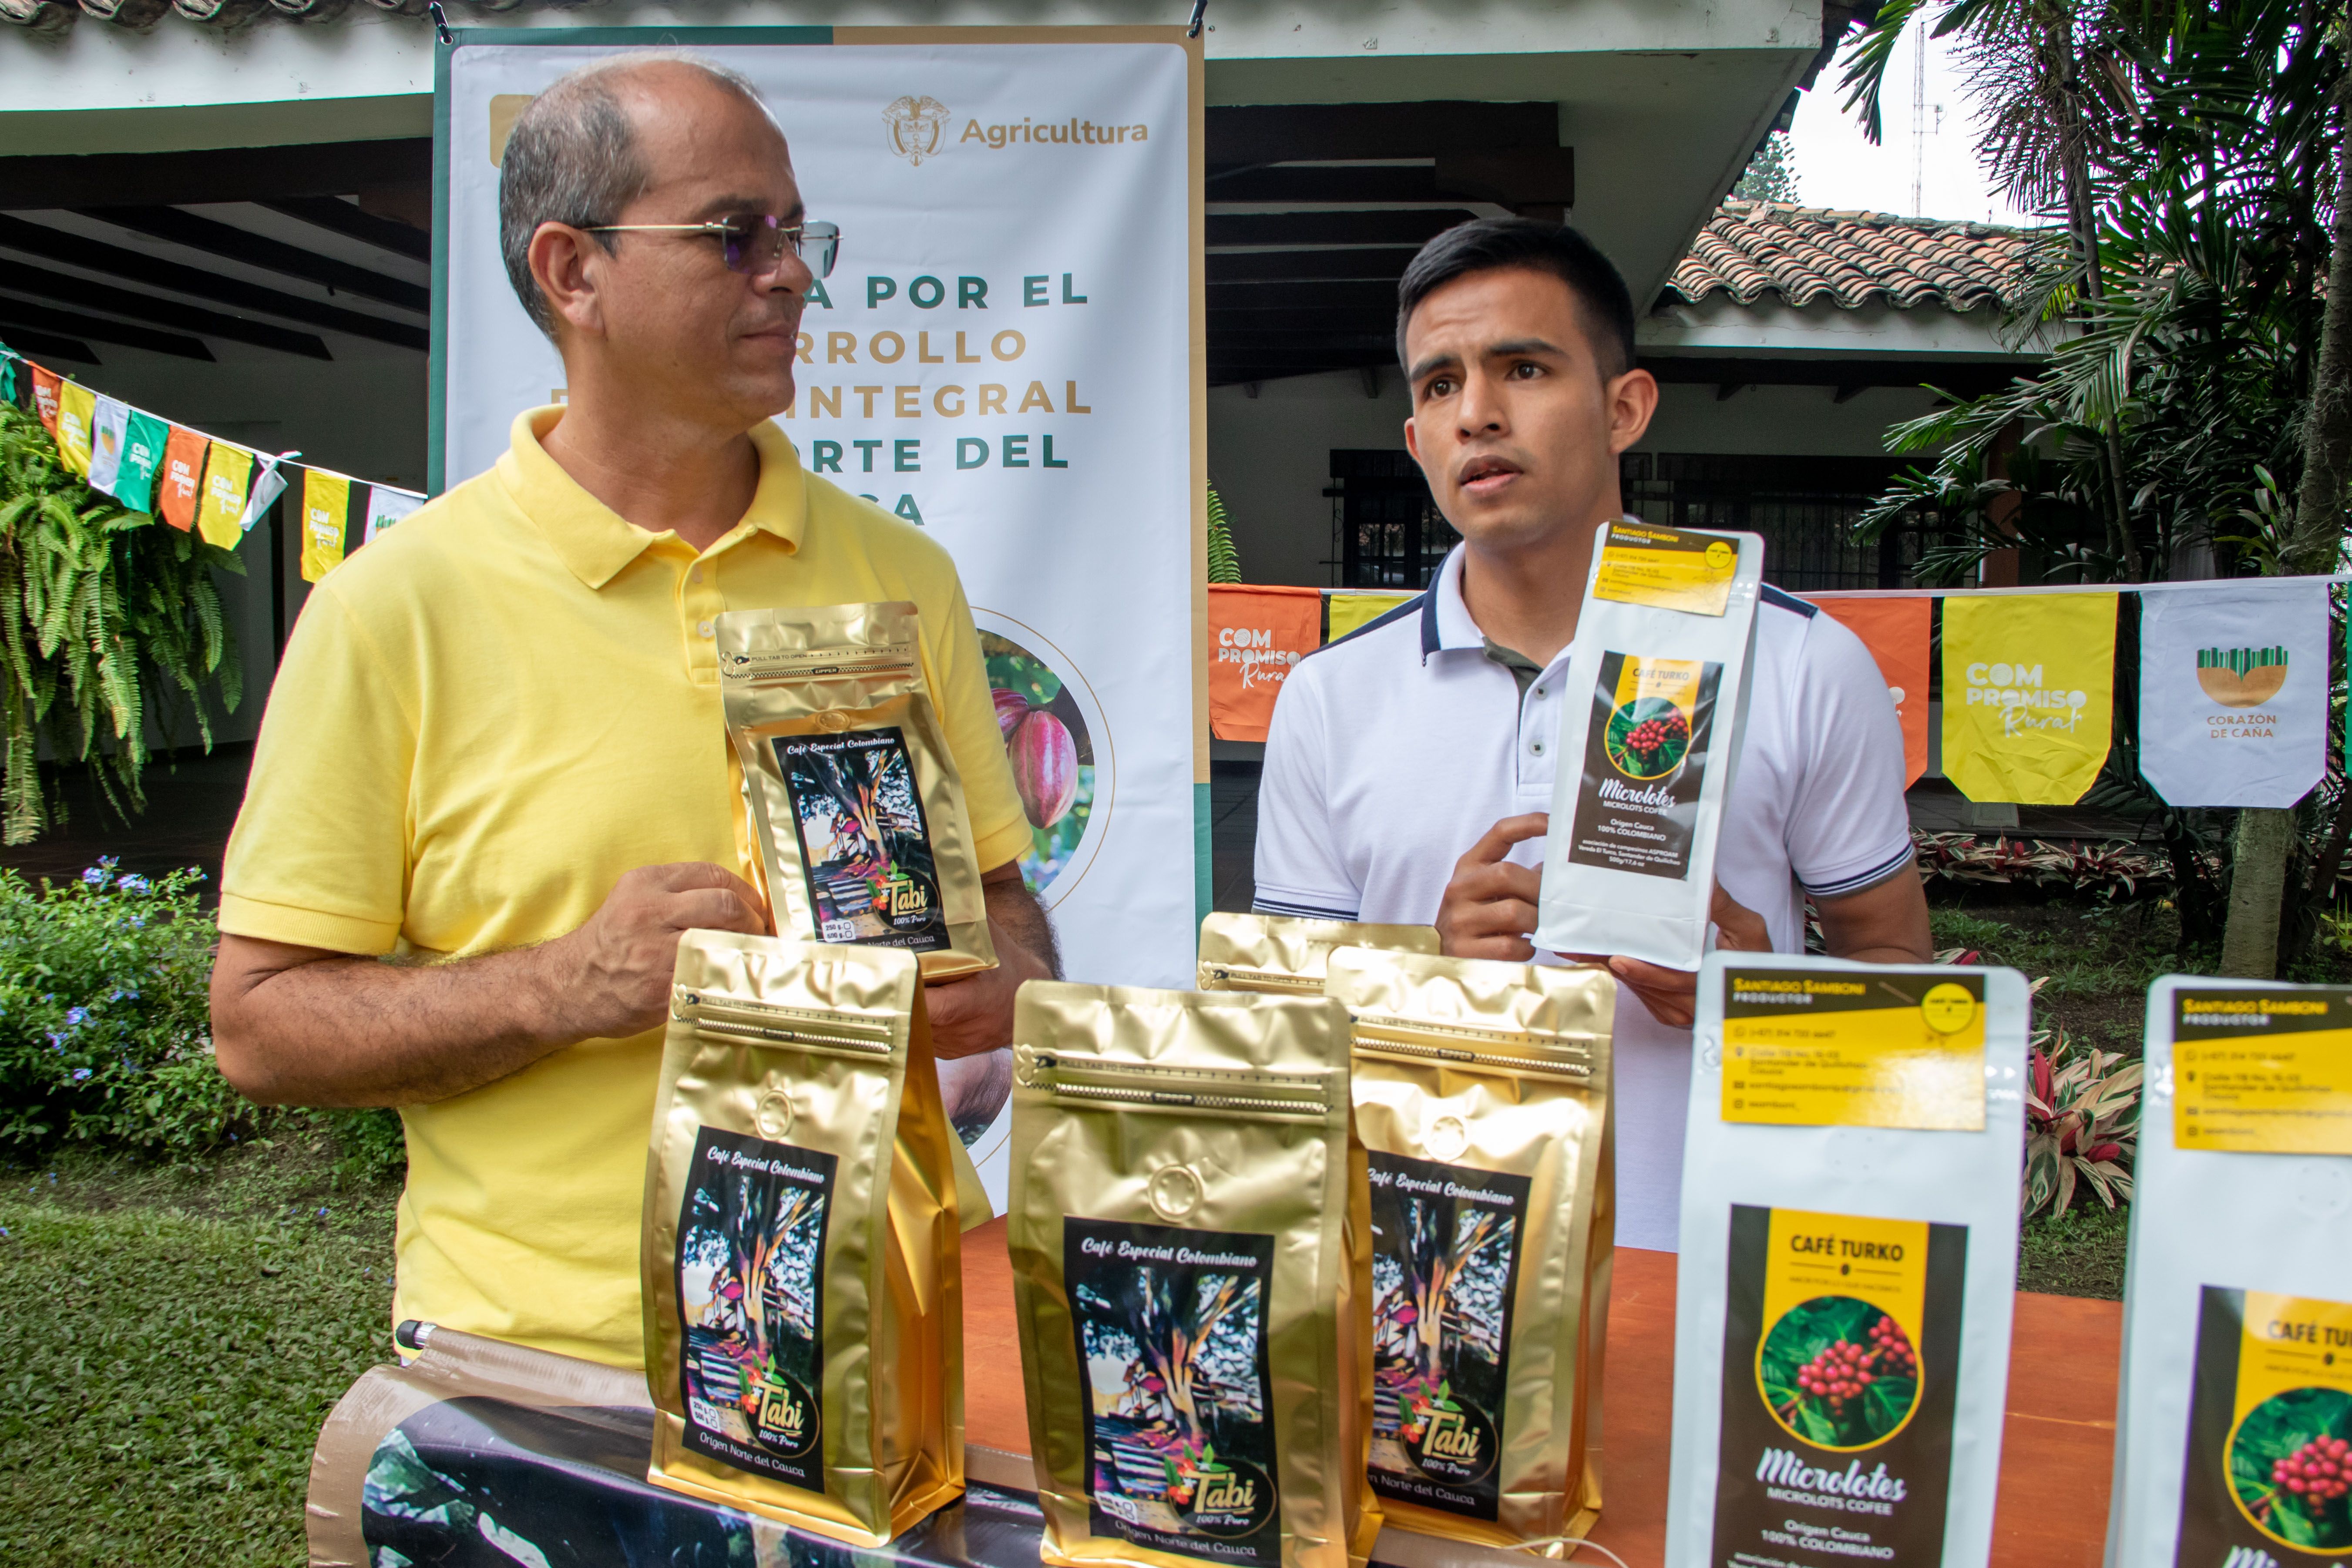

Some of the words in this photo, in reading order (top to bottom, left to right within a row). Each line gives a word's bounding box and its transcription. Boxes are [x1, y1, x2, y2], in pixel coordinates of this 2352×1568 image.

[960, 117, 1148, 149] Agricultura
[867, 275, 988, 309] POR
[1023, 272, 1088, 308] EL
[796, 329, 1026, 364] RROLLO
[792, 439, 921, 473] RTE
[956, 434, 1068, 470] DEL
[171, 460, 190, 476] COM
[170, 471, 196, 489] PROMISO
[212, 475, 233, 492] COM
[211, 487, 242, 504] PROMISO
[310, 507, 330, 524] COM
[309, 520, 340, 537] PROMISO
[1611, 533, 1652, 544] PRODUCTOR
[1219, 628, 1271, 648] COM
[1218, 648, 1301, 666] PROMISO
[1633, 668, 1656, 679] CAFÉ
[1658, 671, 1690, 681] TURKO
[1966, 662, 2043, 688] COM
[1966, 688, 2087, 709] PROMISO
[1998, 703, 2083, 738] Rural
[2207, 713, 2277, 725] CORAZÓN
[2211, 729, 2227, 739] DE
[2231, 726, 2274, 738] CAÑA
[787, 744, 807, 756] Café
[810, 742, 846, 752] Especial
[847, 737, 895, 749] Colombiano
[1598, 777, 1677, 808] Microlotes
[1603, 800, 1643, 813] MICROLOTS
[1643, 806, 1668, 816] COFEE
[1597, 825, 1616, 834] 100%
[1617, 828, 1667, 842] COLOMBIANO
[1610, 818, 1633, 828] Origen
[1634, 822, 1655, 831] Cauca
[881, 879, 929, 917] Tabi
[893, 916, 910, 926] 100%
[911, 915, 927, 923] Puro
[892, 937, 905, 947] del
[907, 935, 935, 945] Cauca
[1733, 991, 1813, 1005] PRODUCTOR
[707, 1145, 730, 1165] Café
[731, 1151, 770, 1170] Especial
[769, 1159, 826, 1184] Colombiano
[1368, 1167, 1393, 1187] Café
[1395, 1172, 1442, 1192] Especial
[1443, 1181, 1515, 1206] Colombiano
[1081, 1237, 1114, 1258] Café
[1117, 1239, 1174, 1261] Especial
[1176, 1246, 1258, 1268] Colombiano
[1790, 1233, 1835, 1256] CAFÉ
[1840, 1239, 1904, 1262] TURKO
[2267, 1319, 2318, 1343] CAFÉ
[753, 1378, 805, 1430] Tabi
[759, 1429, 778, 1442] 100%
[778, 1434, 800, 1449] Puro
[1419, 1407, 1481, 1457] Tabi
[699, 1431, 728, 1453] Origen
[730, 1443, 753, 1461] Norte
[754, 1454, 770, 1468] del
[771, 1459, 806, 1478] Cauca
[1421, 1457, 1446, 1471] 100%
[1446, 1462, 1471, 1477] Puro
[1755, 1446, 1908, 1503] Microlotes
[1183, 1469, 1257, 1514] Tabi
[1381, 1474, 1412, 1491] Norte
[1413, 1483, 1433, 1497] del
[1435, 1487, 1475, 1506] Cauca
[1766, 1486, 1845, 1511] MICROLOTS
[1845, 1498, 1893, 1516] COFEE
[1195, 1514, 1222, 1524] 100%
[1223, 1514, 1250, 1526] Puro
[1784, 1519, 1830, 1537] Origen
[1830, 1526, 1871, 1543] Cauca
[1155, 1533, 1188, 1548] Norte
[1189, 1540, 1210, 1552] del
[1213, 1542, 1257, 1557] Cauca
[1761, 1529, 1798, 1547] 100%
[1798, 1535, 1895, 1561] COLOMBIANO
